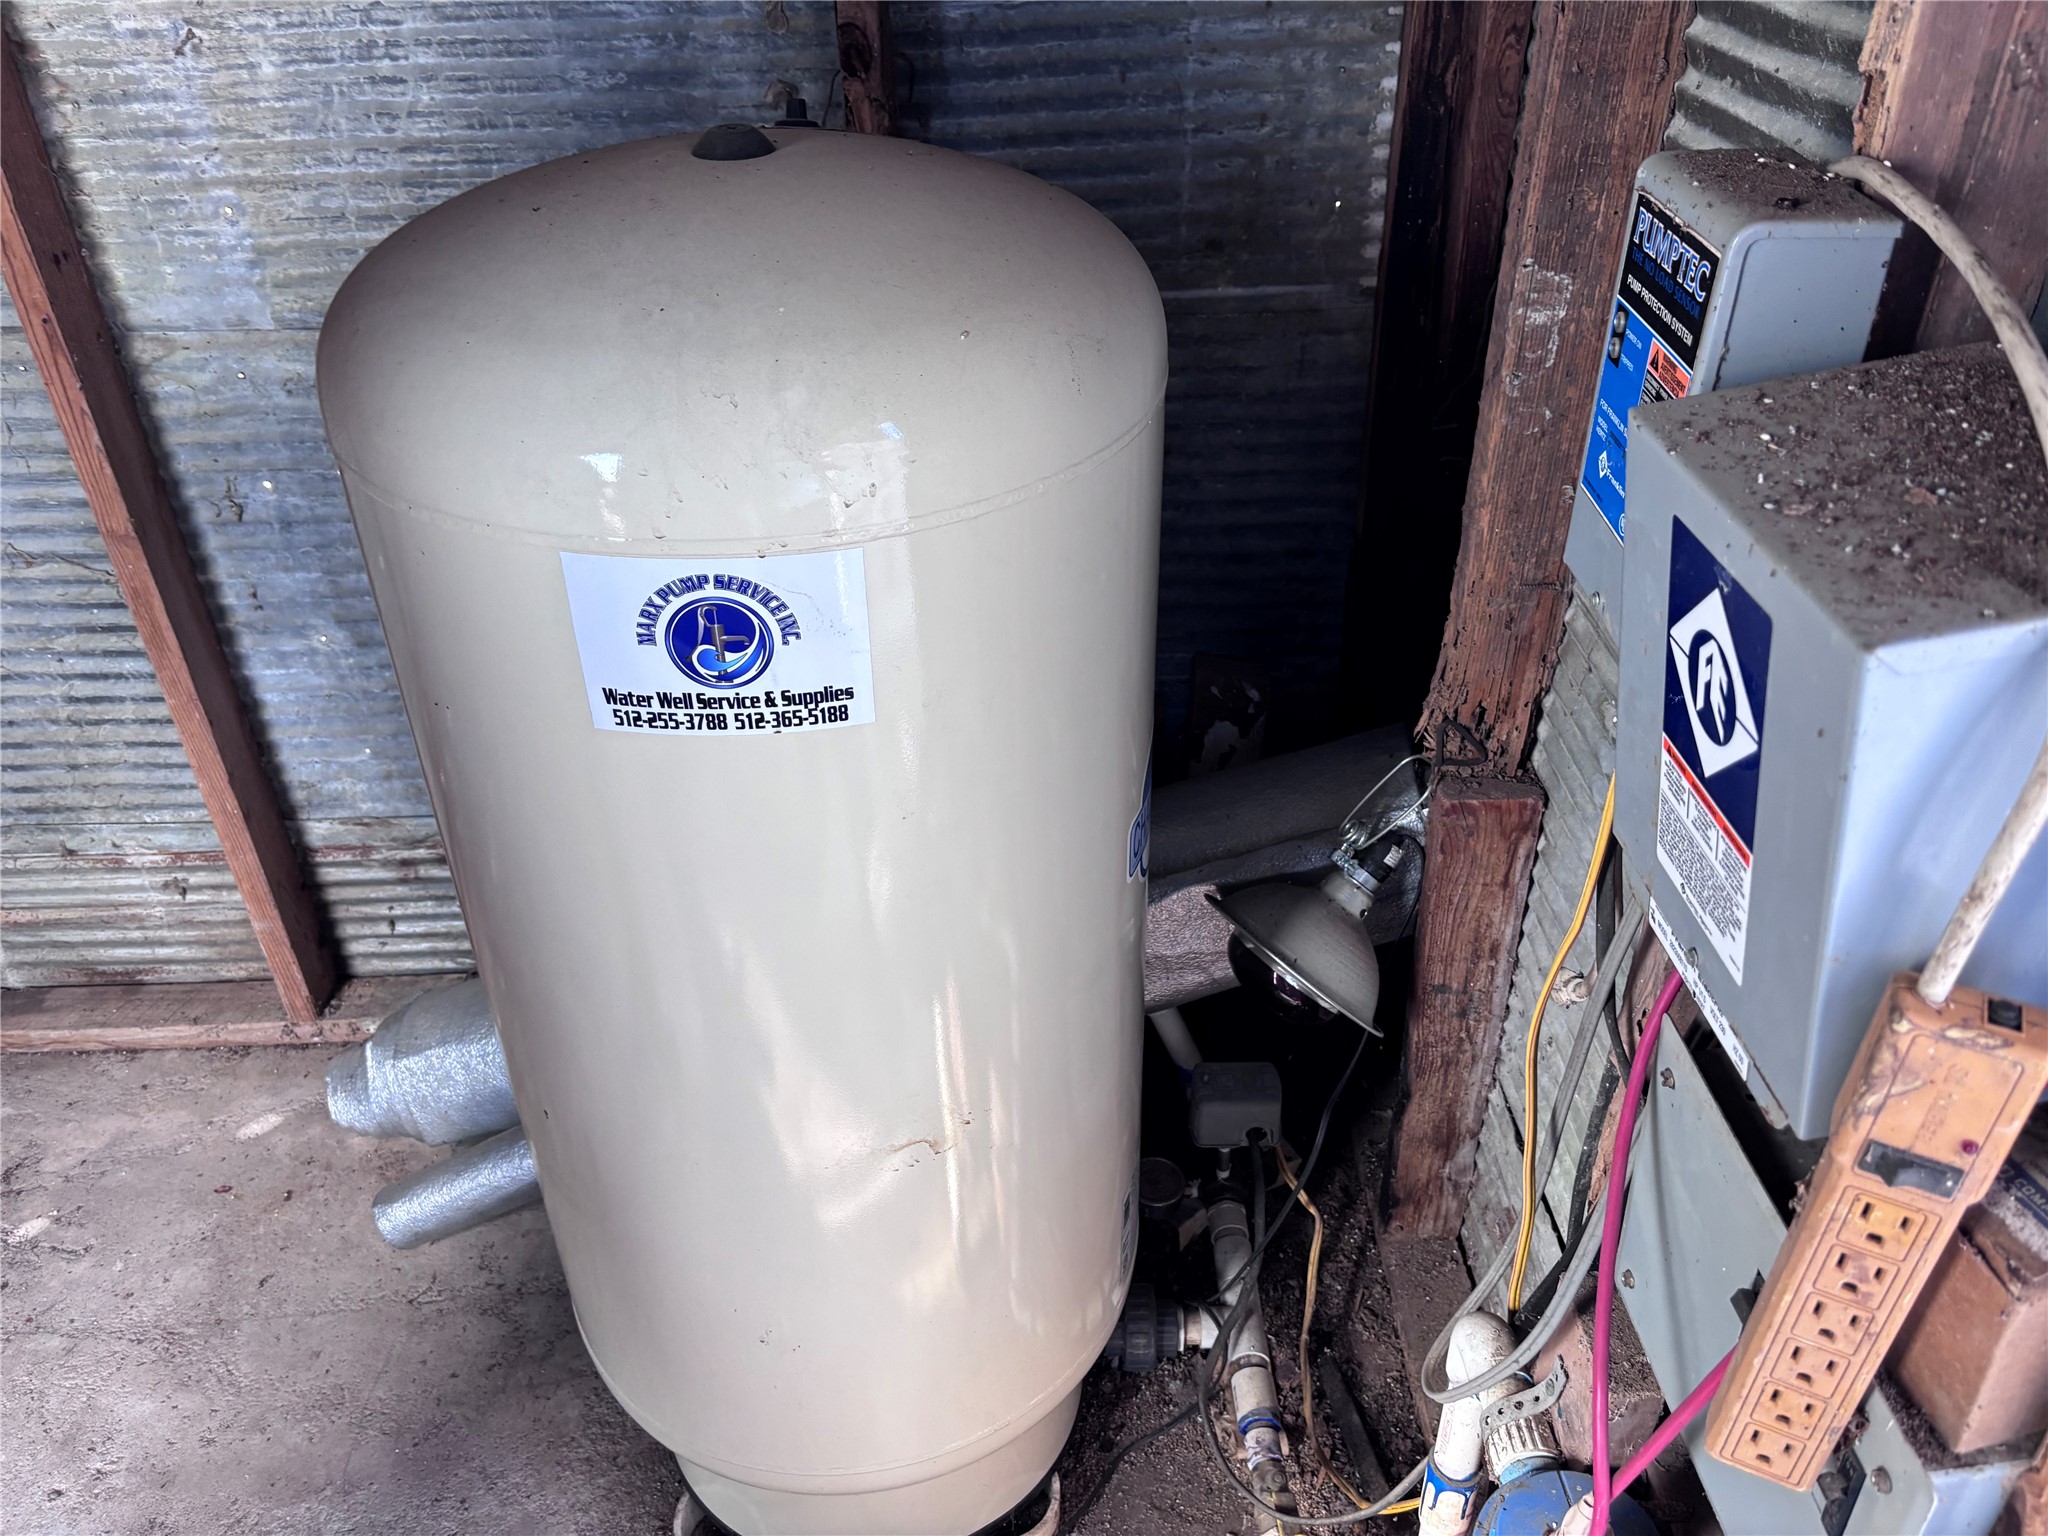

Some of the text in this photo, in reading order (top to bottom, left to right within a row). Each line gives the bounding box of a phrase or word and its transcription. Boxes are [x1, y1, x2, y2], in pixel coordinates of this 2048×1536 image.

[1632, 246, 1700, 320] THE NO LOAD SENSOR
[1633, 206, 1711, 302] PUMPTEC
[1627, 273, 1694, 347] PUMP PROTECTION SYSTEM
[1606, 468, 1625, 499] Franklin
[636, 573, 802, 646] MARX PUMP SERVICE INC
[602, 685, 854, 710] Water Well Service & Supplies
[612, 704, 849, 730] 512-255-3788 512-365-5188
